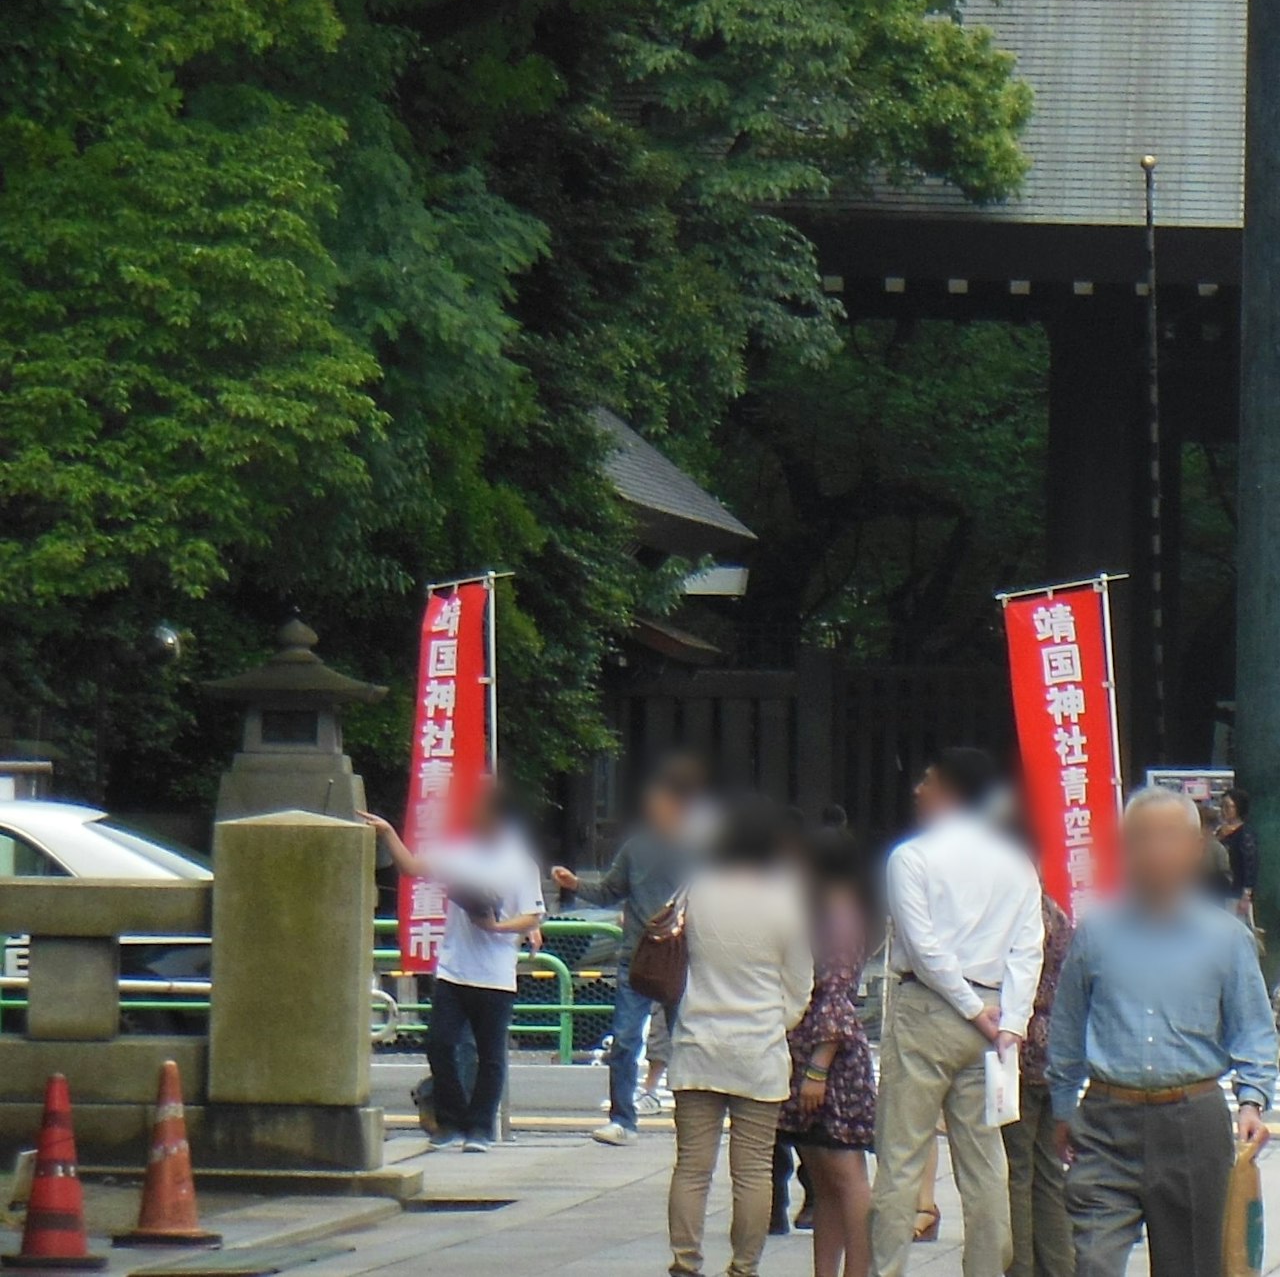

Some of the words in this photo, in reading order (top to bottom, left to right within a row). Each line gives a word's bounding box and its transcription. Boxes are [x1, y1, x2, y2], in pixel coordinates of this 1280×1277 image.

[410, 598, 462, 962] 靖国神社青空董市
